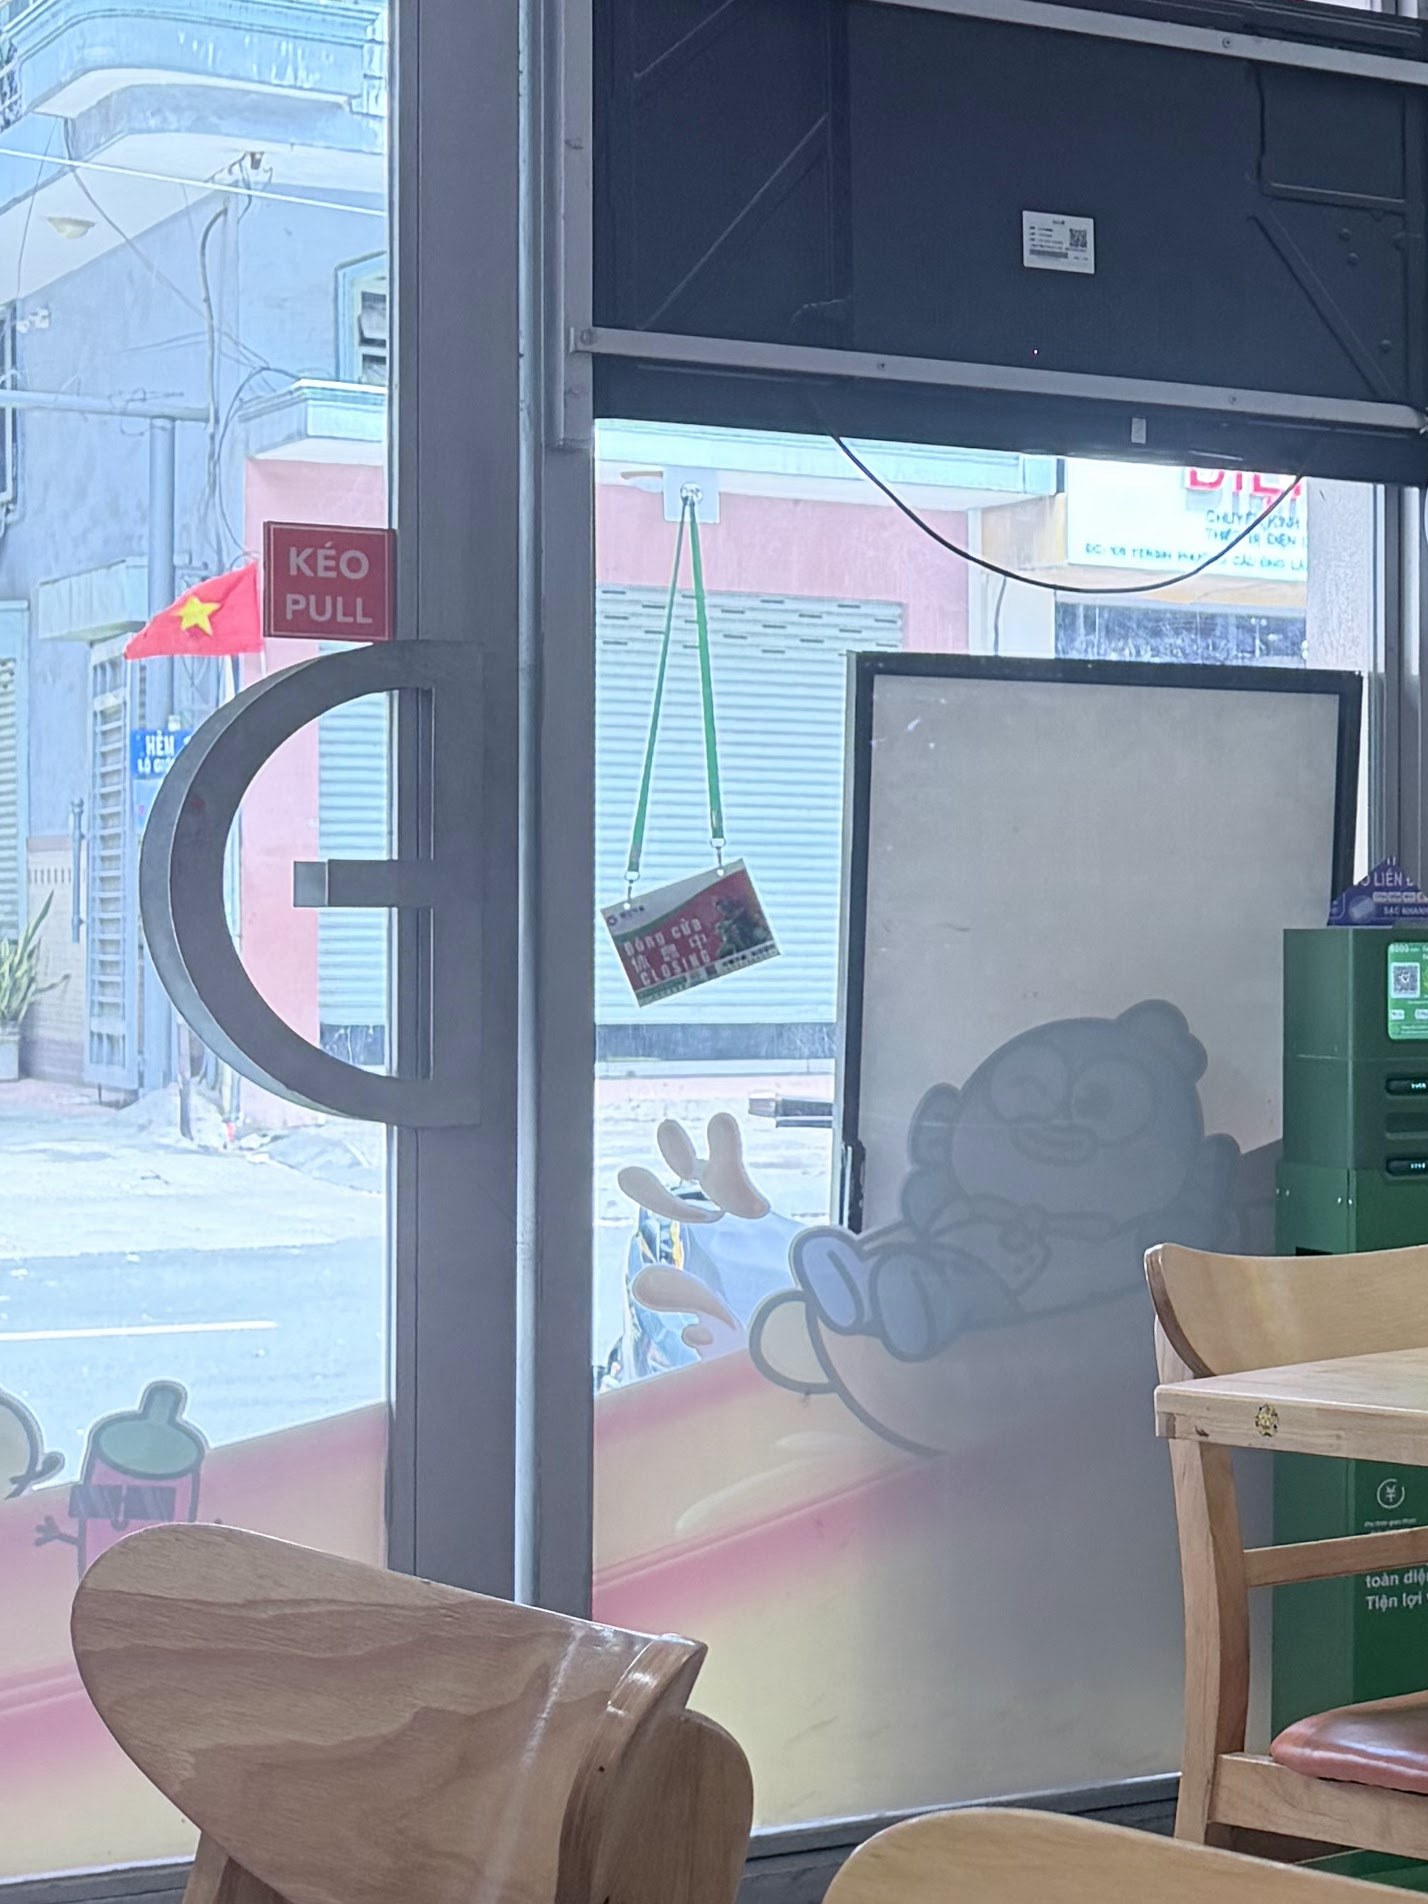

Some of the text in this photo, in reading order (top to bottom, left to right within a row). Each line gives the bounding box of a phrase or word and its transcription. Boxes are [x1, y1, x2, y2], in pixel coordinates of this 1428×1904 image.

[288, 541, 370, 580] KÉO
[285, 592, 373, 625] PULL
[639, 949, 711, 986] CLOSING
[1365, 1571, 1399, 1589] toàn
[1365, 1595, 1399, 1612] Tiện
[1402, 1591, 1423, 1610] lợi
